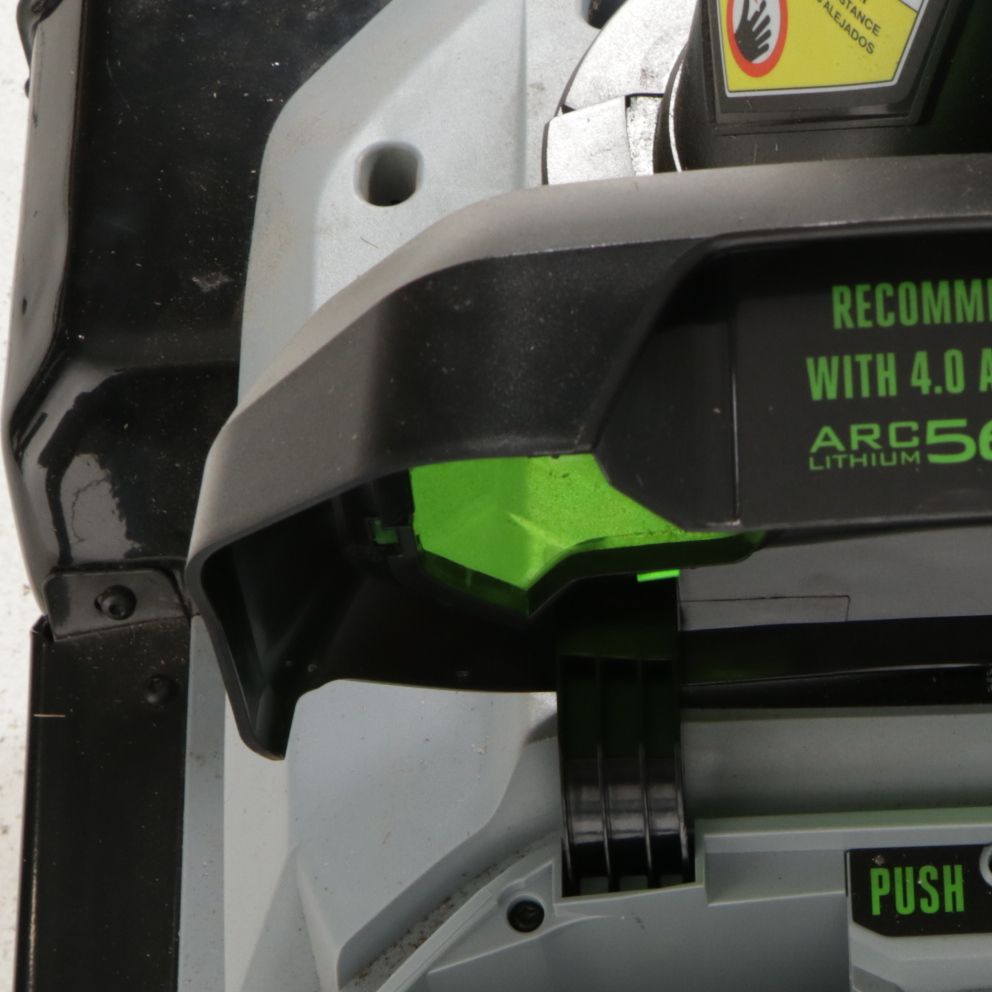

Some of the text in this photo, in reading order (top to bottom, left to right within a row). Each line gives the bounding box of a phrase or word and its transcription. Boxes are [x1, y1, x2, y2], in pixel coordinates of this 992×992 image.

[823, 1, 875, 55] ALEJADOS
[806, 352, 898, 401] WITH
[910, 348, 965, 394] 4.0
[809, 450, 921, 471] LITHIUM
[810, 420, 920, 453] ARC
[870, 864, 965, 915] PUSH
